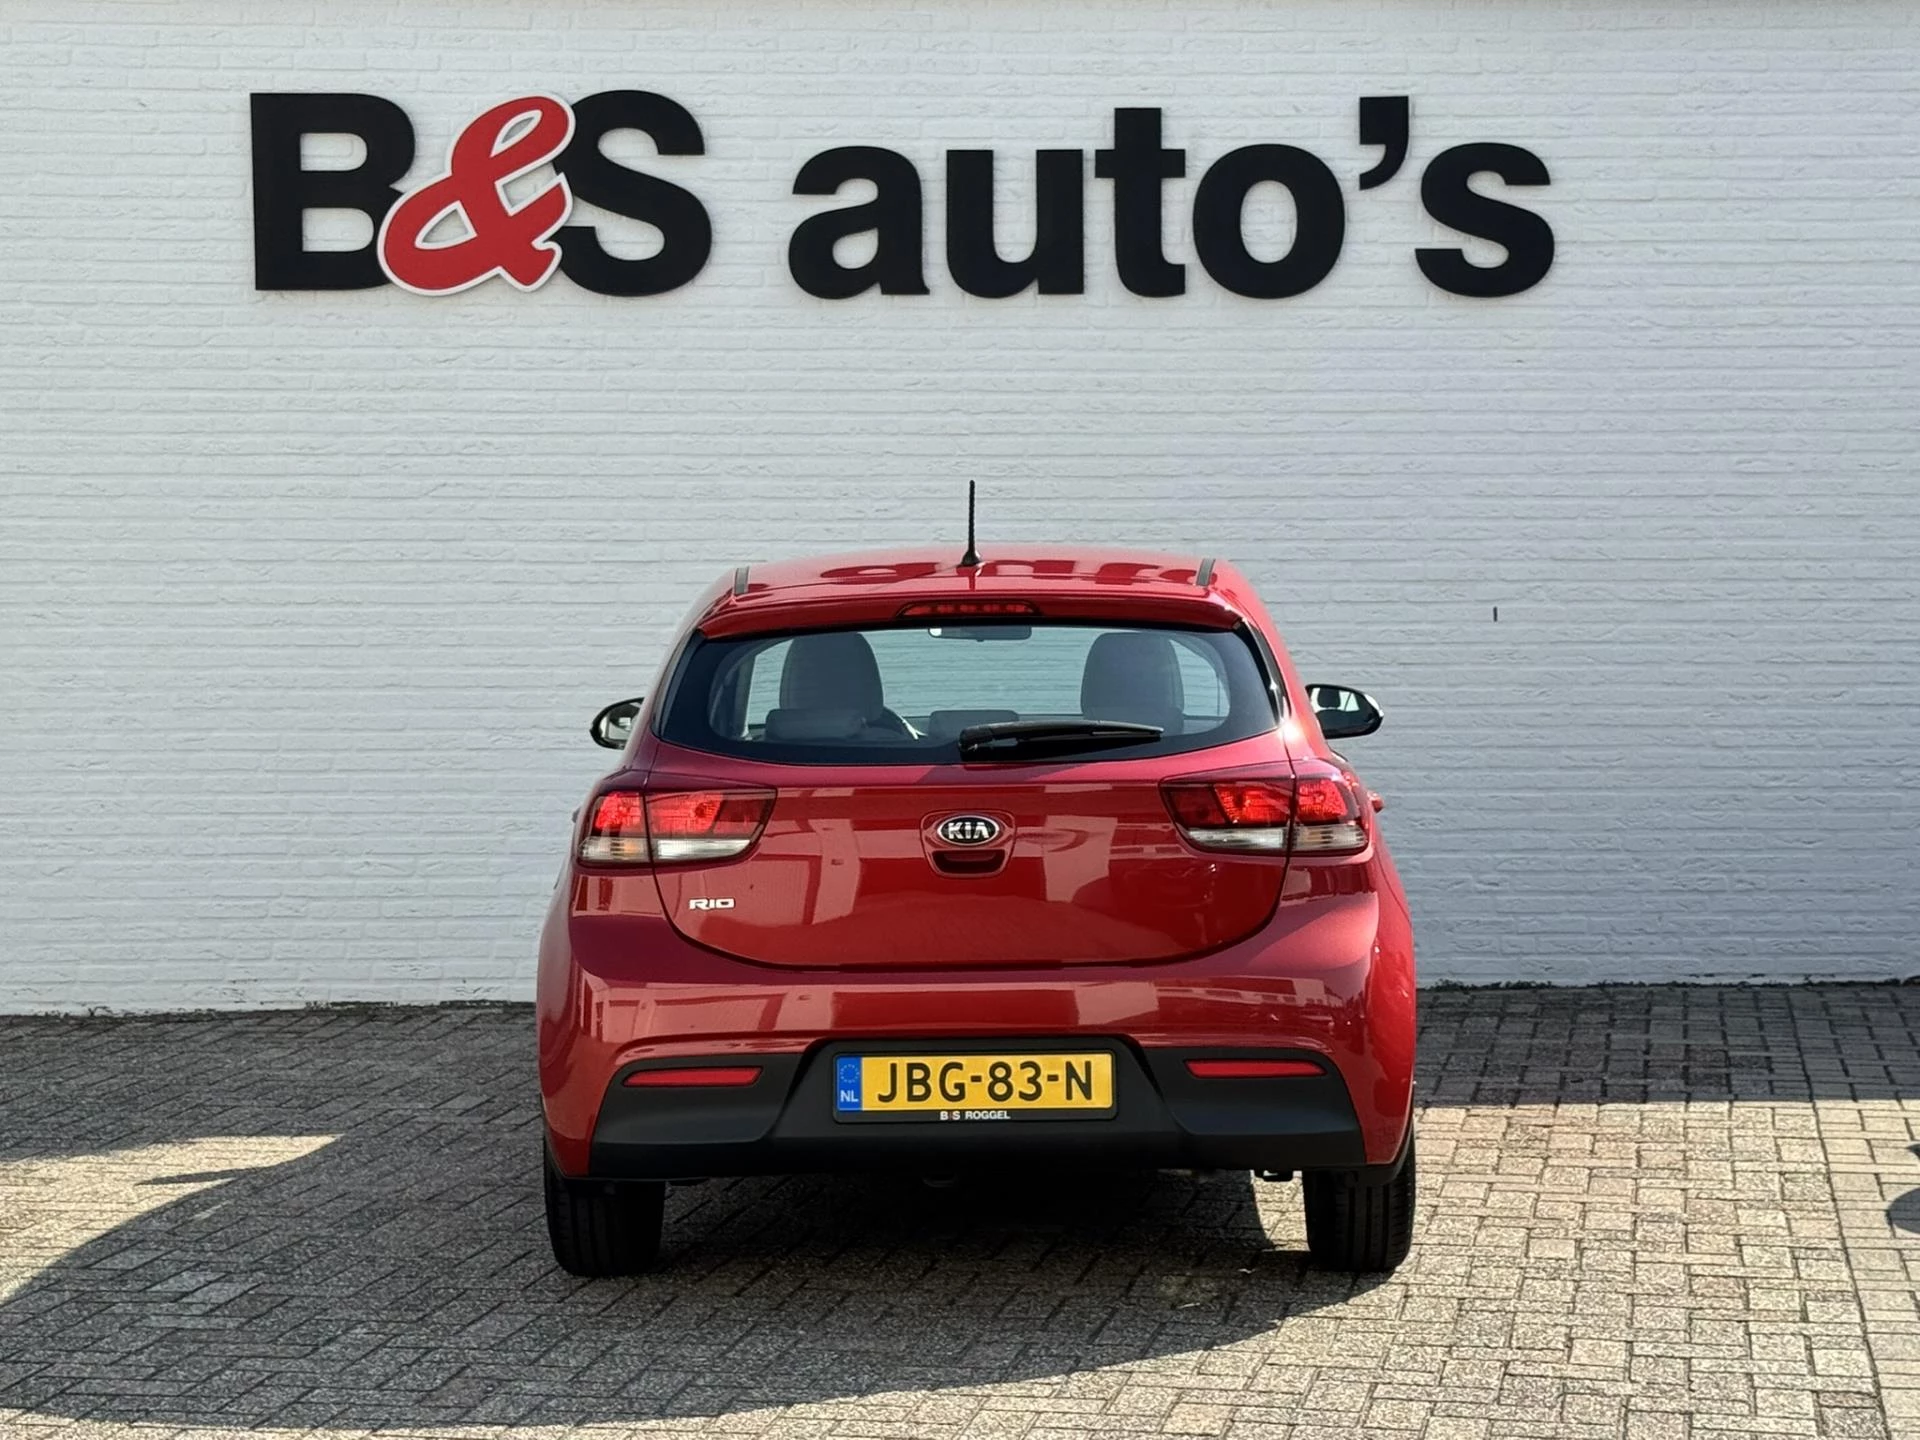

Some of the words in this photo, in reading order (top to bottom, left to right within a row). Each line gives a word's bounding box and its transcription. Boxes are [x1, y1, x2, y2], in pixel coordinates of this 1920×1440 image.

[250, 89, 711, 297] B&S
[788, 95, 1555, 299] auto's
[948, 822, 990, 839] KIA
[689, 898, 735, 911] RIO
[877, 1060, 1092, 1103] JBG-83-N
[840, 1090, 859, 1102] NL
[964, 1110, 1011, 1120] ROGGEL
